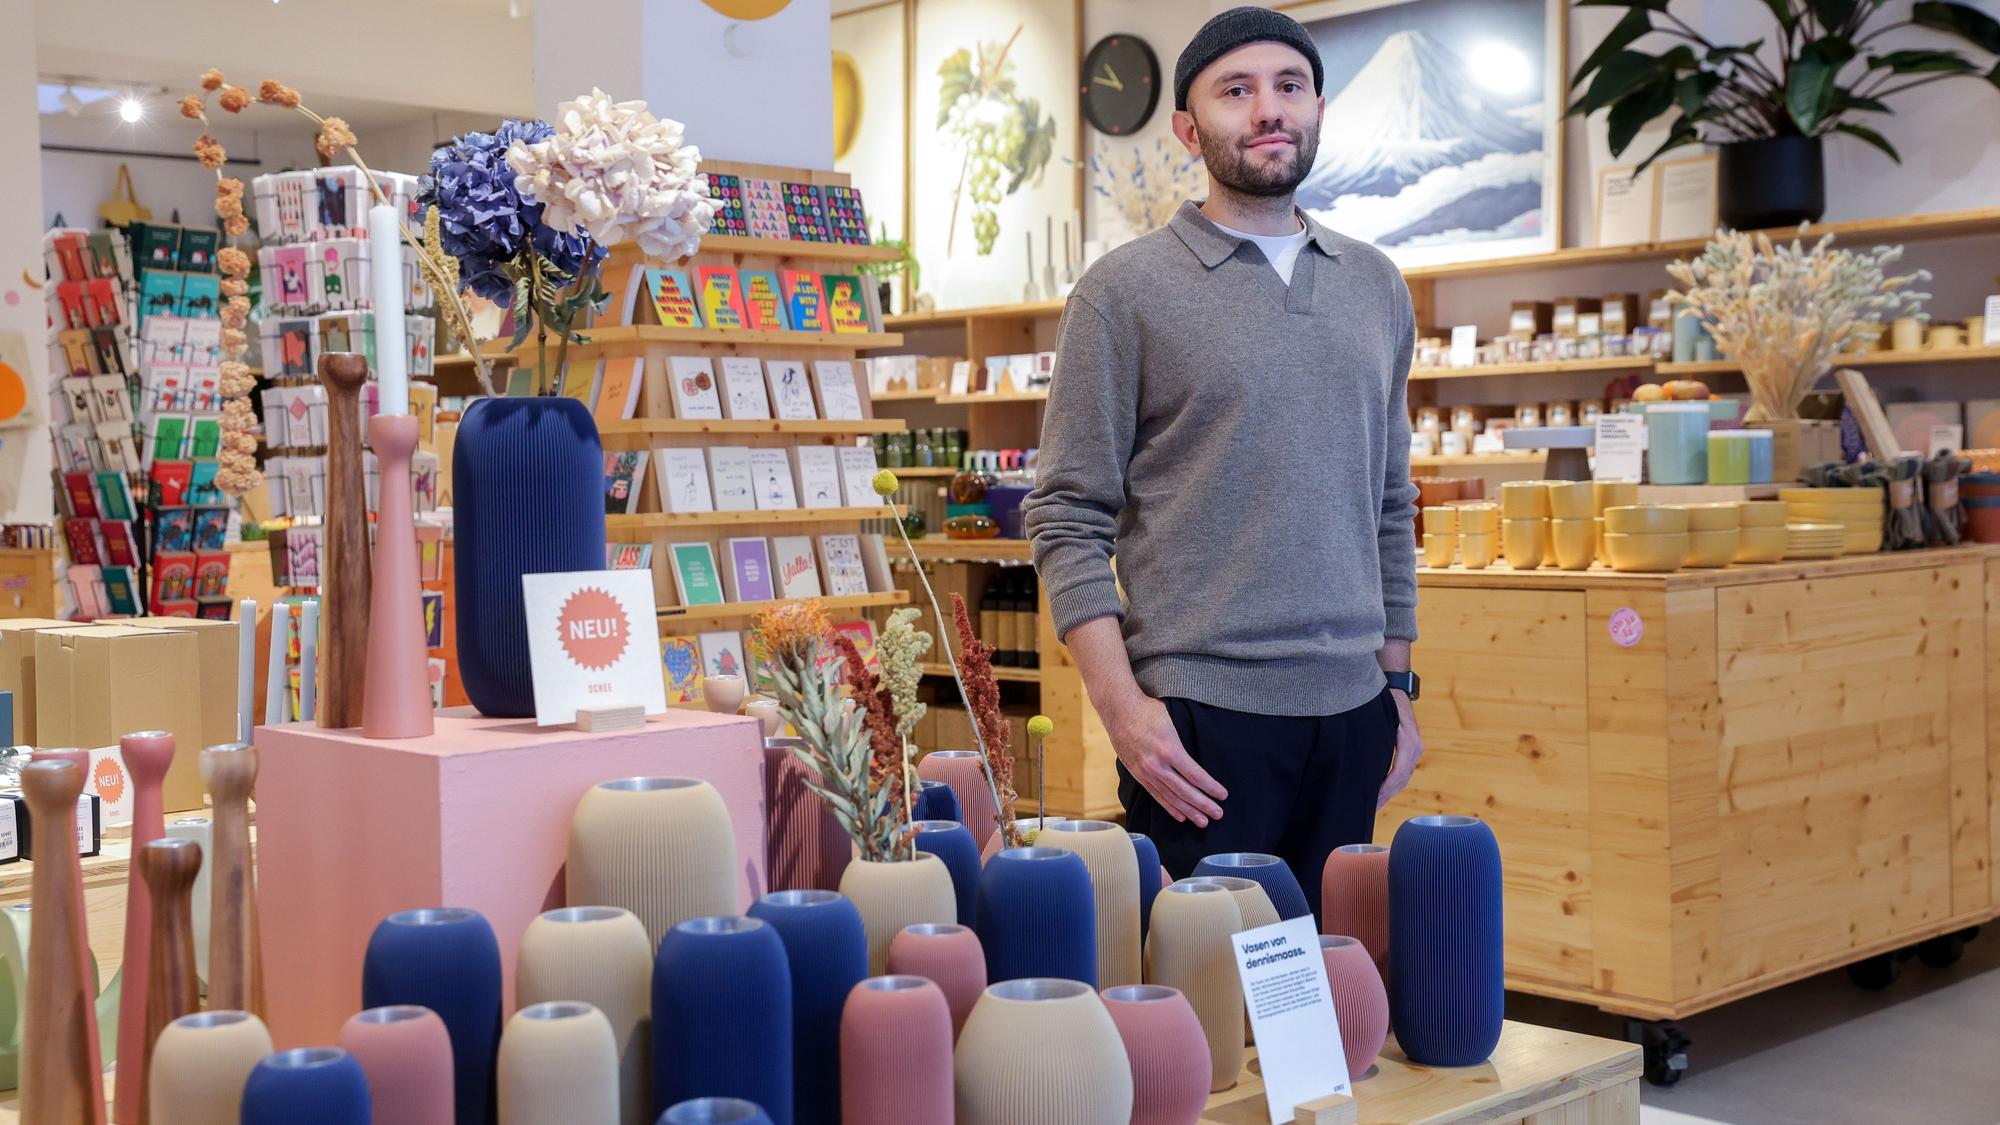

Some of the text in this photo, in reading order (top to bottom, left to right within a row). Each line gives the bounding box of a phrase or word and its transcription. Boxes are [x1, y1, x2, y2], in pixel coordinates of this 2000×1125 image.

[569, 618, 618, 640] NEU!
[99, 774, 119, 787] NEU!
[1242, 936, 1287, 954] Vasen von
[1246, 947, 1306, 969] dennismaass.
